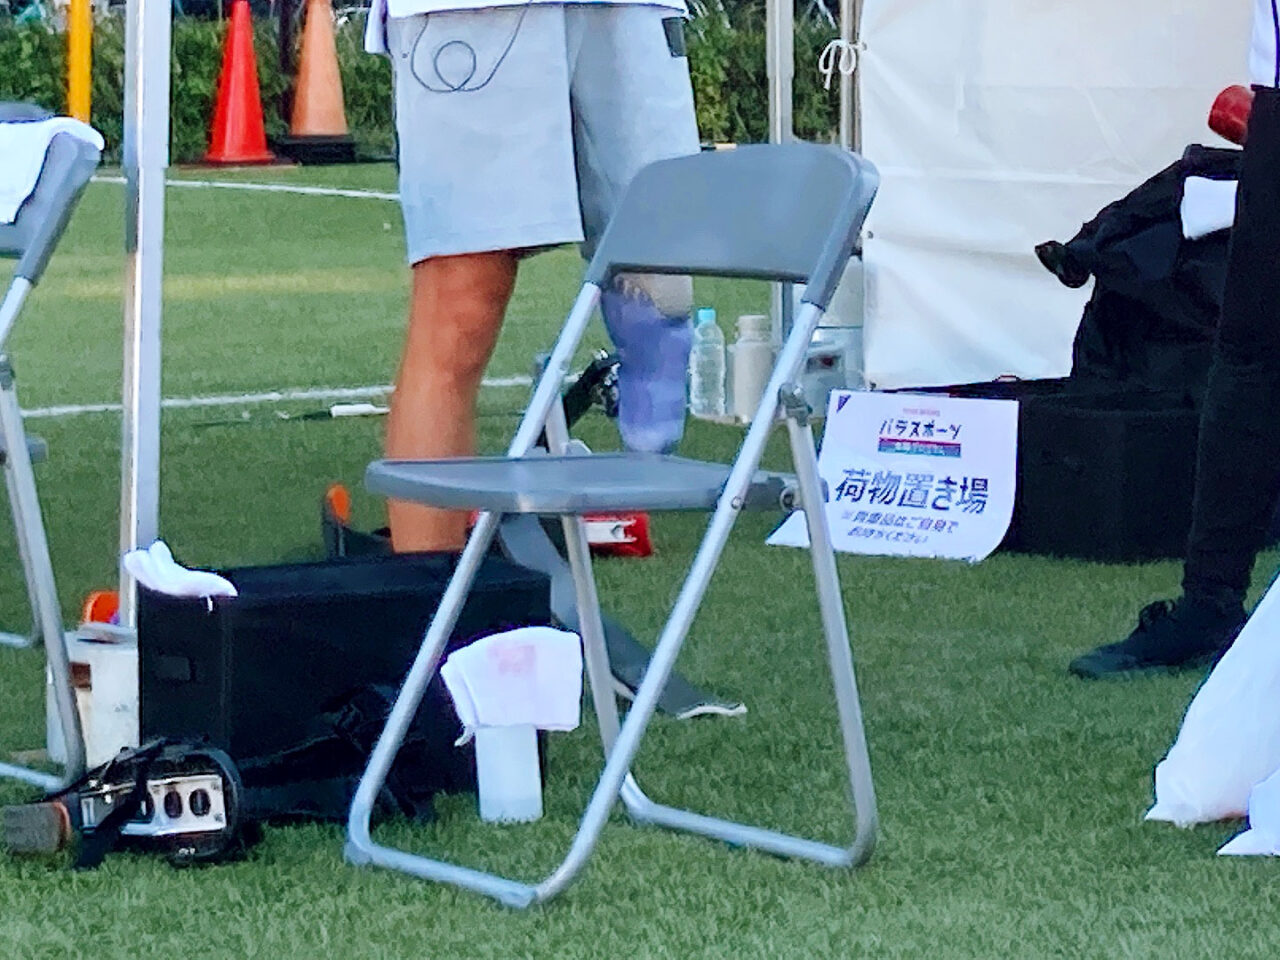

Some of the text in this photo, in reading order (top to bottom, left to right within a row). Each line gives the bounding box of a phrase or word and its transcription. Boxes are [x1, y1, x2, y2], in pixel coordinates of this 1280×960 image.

[835, 468, 989, 515] 荷物置き場
